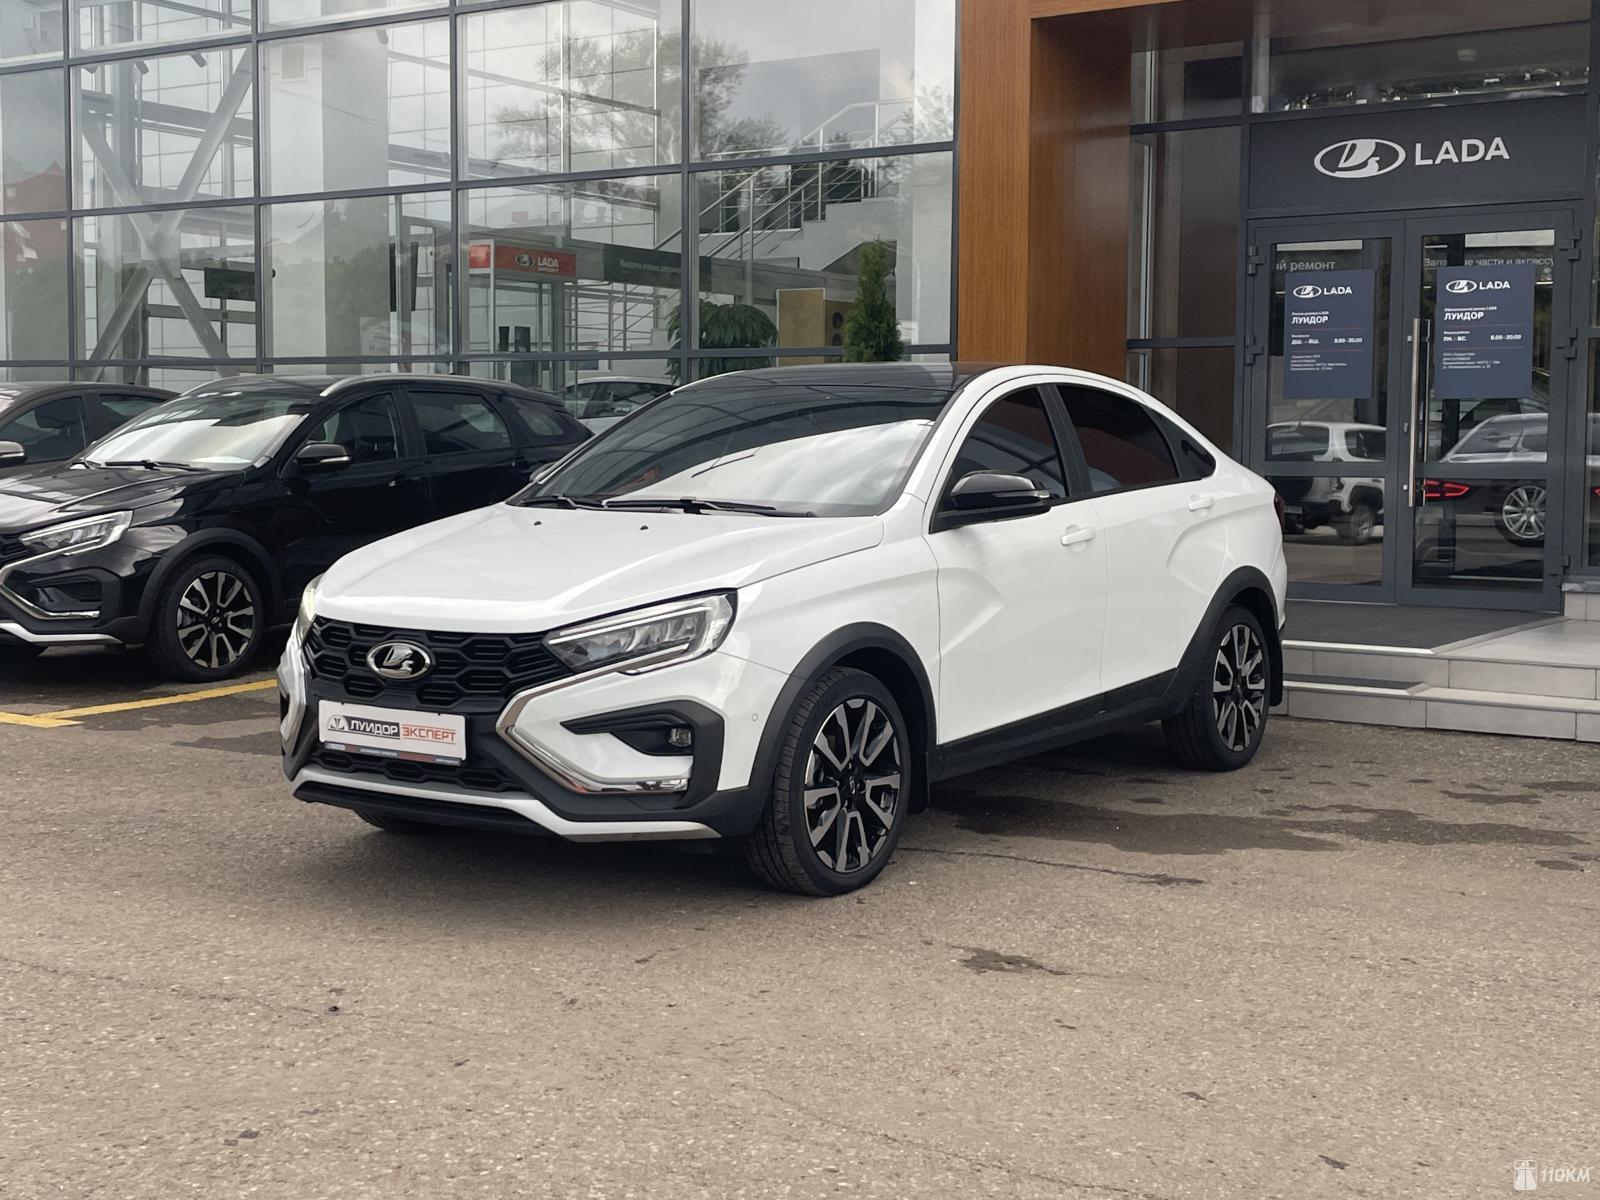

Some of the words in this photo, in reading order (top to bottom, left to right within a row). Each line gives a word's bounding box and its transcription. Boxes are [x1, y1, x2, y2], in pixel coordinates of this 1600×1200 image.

[1415, 137, 1510, 166] LADA
[537, 256, 560, 268] LADA
[1290, 261, 1336, 272] ремонт
[1323, 286, 1353, 295] LADA
[1479, 281, 1511, 290] LADA
[1291, 316, 1329, 325] ЛУИДОР
[1443, 311, 1485, 321] ЛУИДОР
[350, 719, 398, 736] ЛУИДОР
[402, 726, 457, 742] ЭКСПЕРТ
